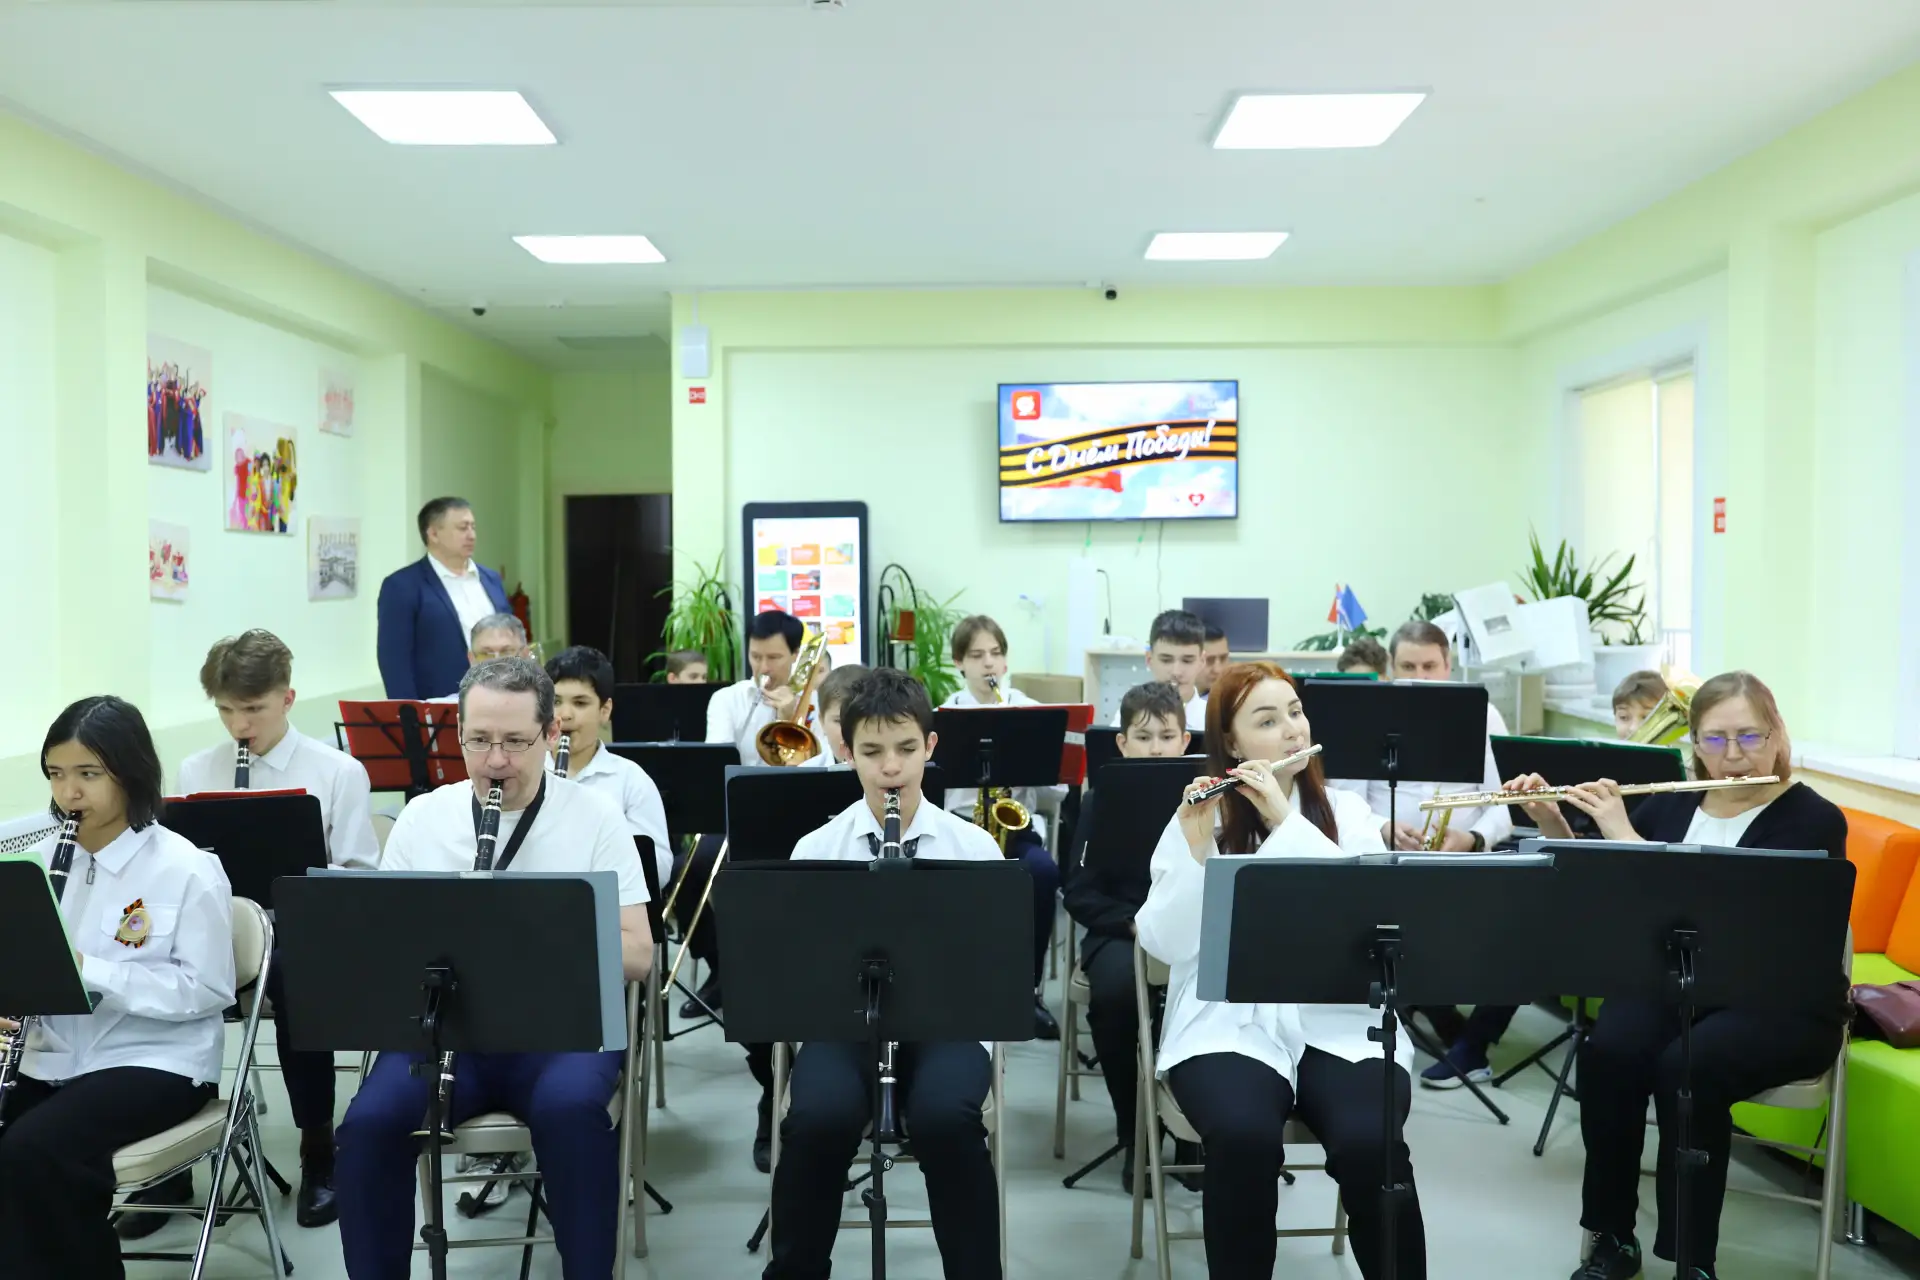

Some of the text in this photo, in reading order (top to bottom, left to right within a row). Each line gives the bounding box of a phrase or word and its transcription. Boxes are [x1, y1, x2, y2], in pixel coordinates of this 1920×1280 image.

[1025, 419, 1216, 475] С Днём Победы!
